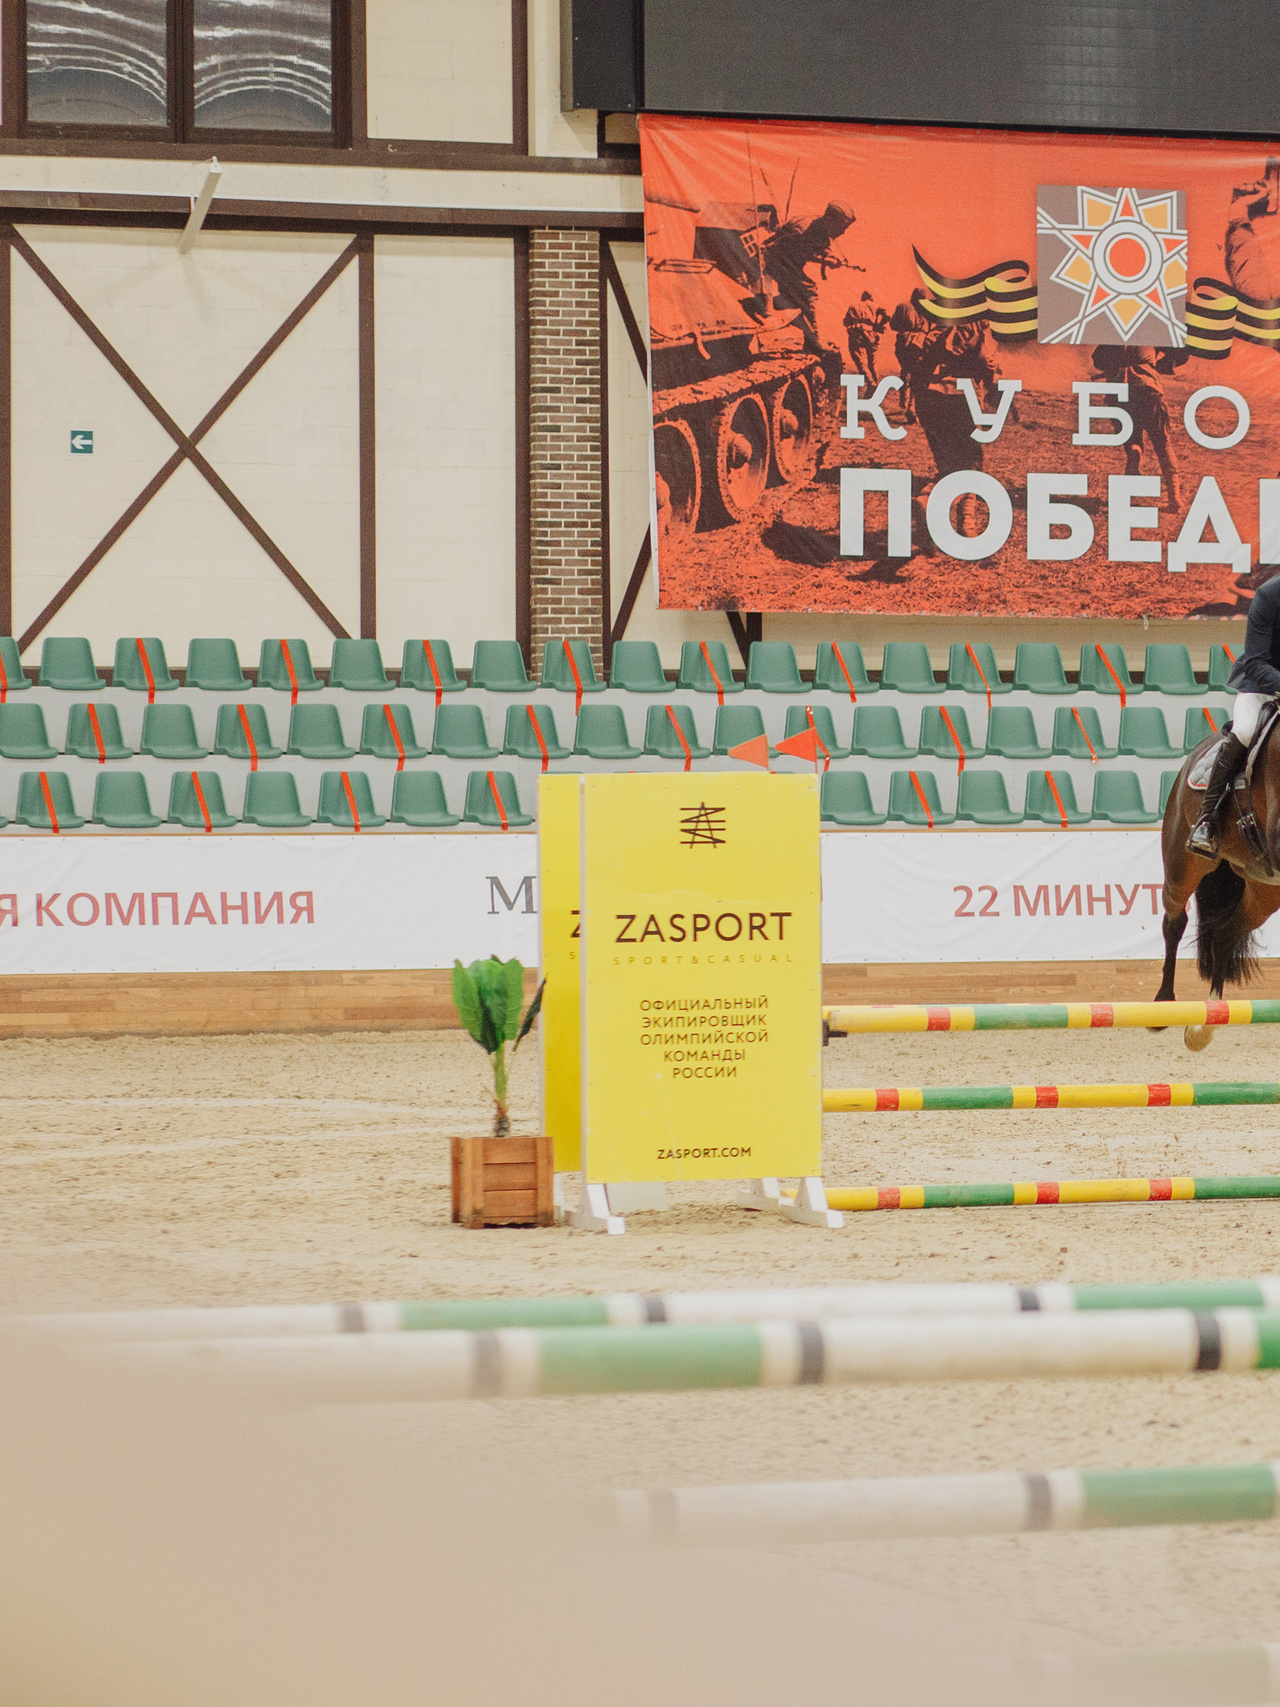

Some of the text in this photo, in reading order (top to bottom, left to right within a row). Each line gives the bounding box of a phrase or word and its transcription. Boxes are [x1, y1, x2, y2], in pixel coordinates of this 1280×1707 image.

[953, 884, 1000, 918] 22
[1012, 882, 1191, 917] МИНУТ
[36, 890, 315, 927] КОМПАНИЯ
[615, 912, 792, 943] ZASPORT
[613, 954, 792, 966] SPORT&CASUAL
[640, 995, 769, 1013] ОФИЦИАЛЬНЫЙ
[642, 1014, 767, 1029] ЭКИПИРОВЩИК
[640, 1029, 769, 1046] ОЛИМПИЙСКОЙ
[663, 1049, 746, 1062] КОМАНДЫ
[673, 1066, 737, 1079] РОССИИ
[657, 1147, 752, 1160] ZASPORT.COM
